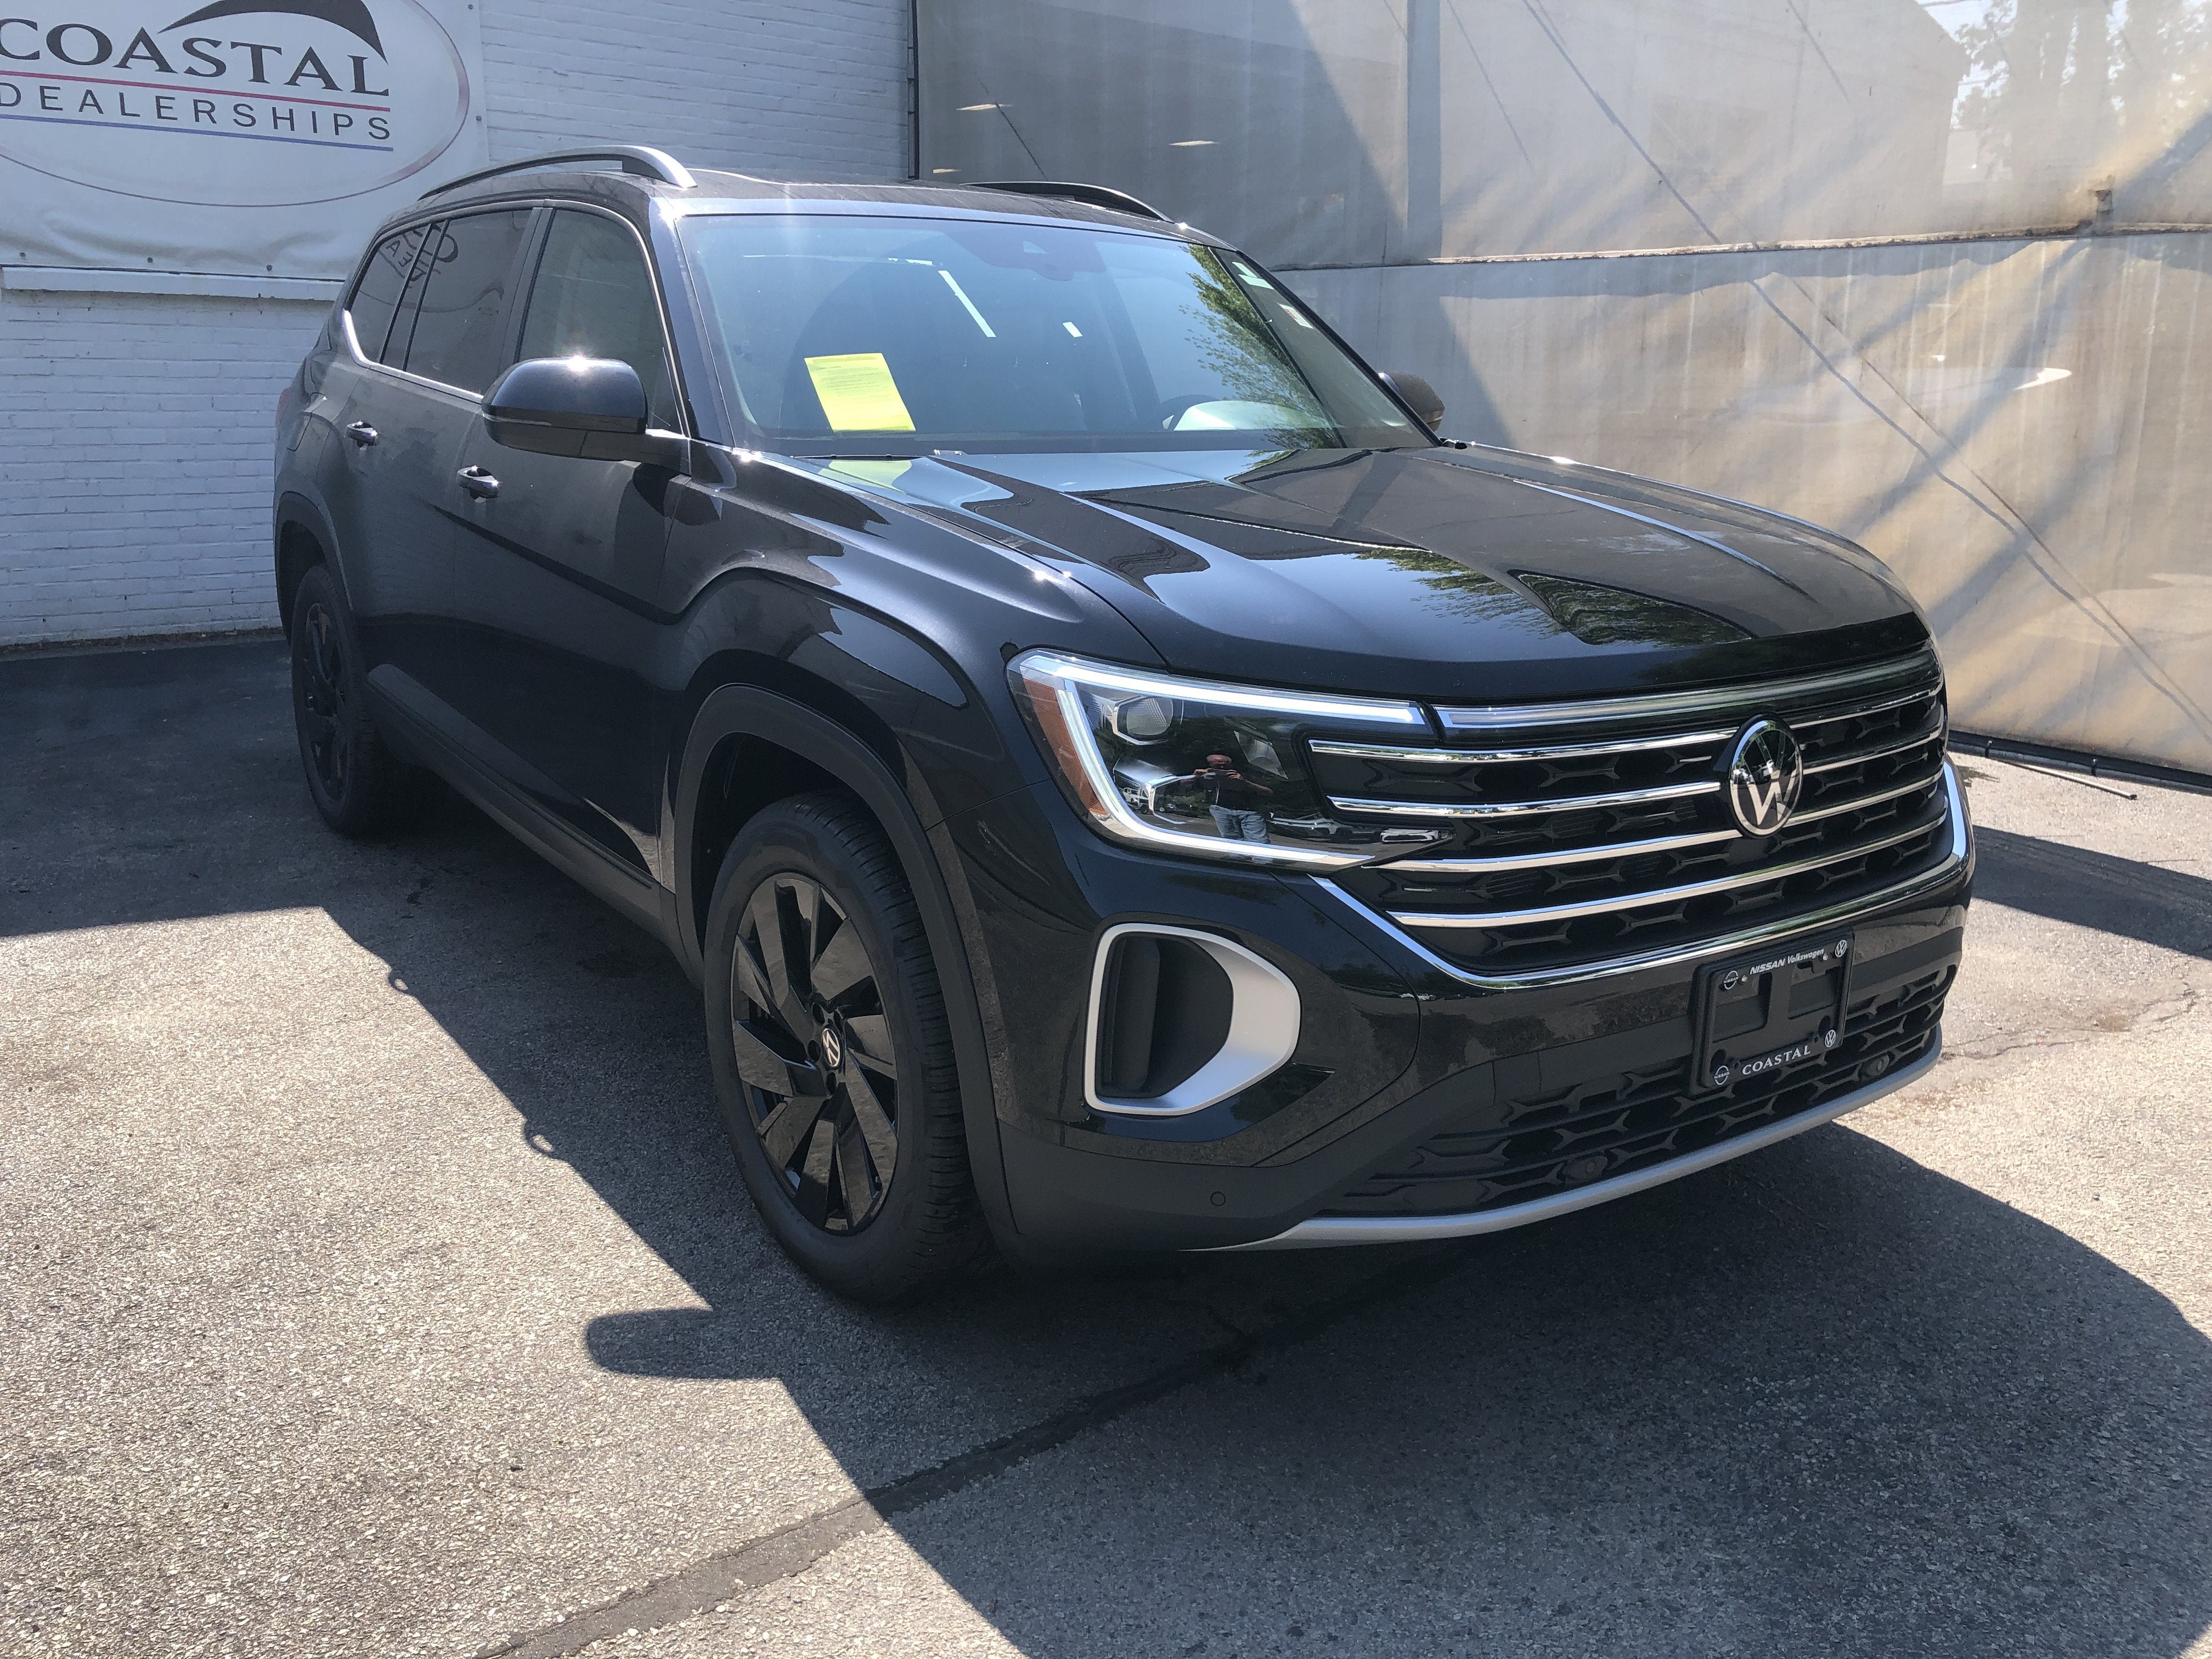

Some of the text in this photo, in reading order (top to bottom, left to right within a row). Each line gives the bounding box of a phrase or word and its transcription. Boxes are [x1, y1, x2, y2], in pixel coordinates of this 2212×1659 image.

[0, 18, 389, 97] COASTAL
[0, 82, 391, 140] DEALERSHIPS
[1750, 948, 1824, 975] NISSAN Volkswagen
[1742, 1045, 1811, 1075] COASTAL
